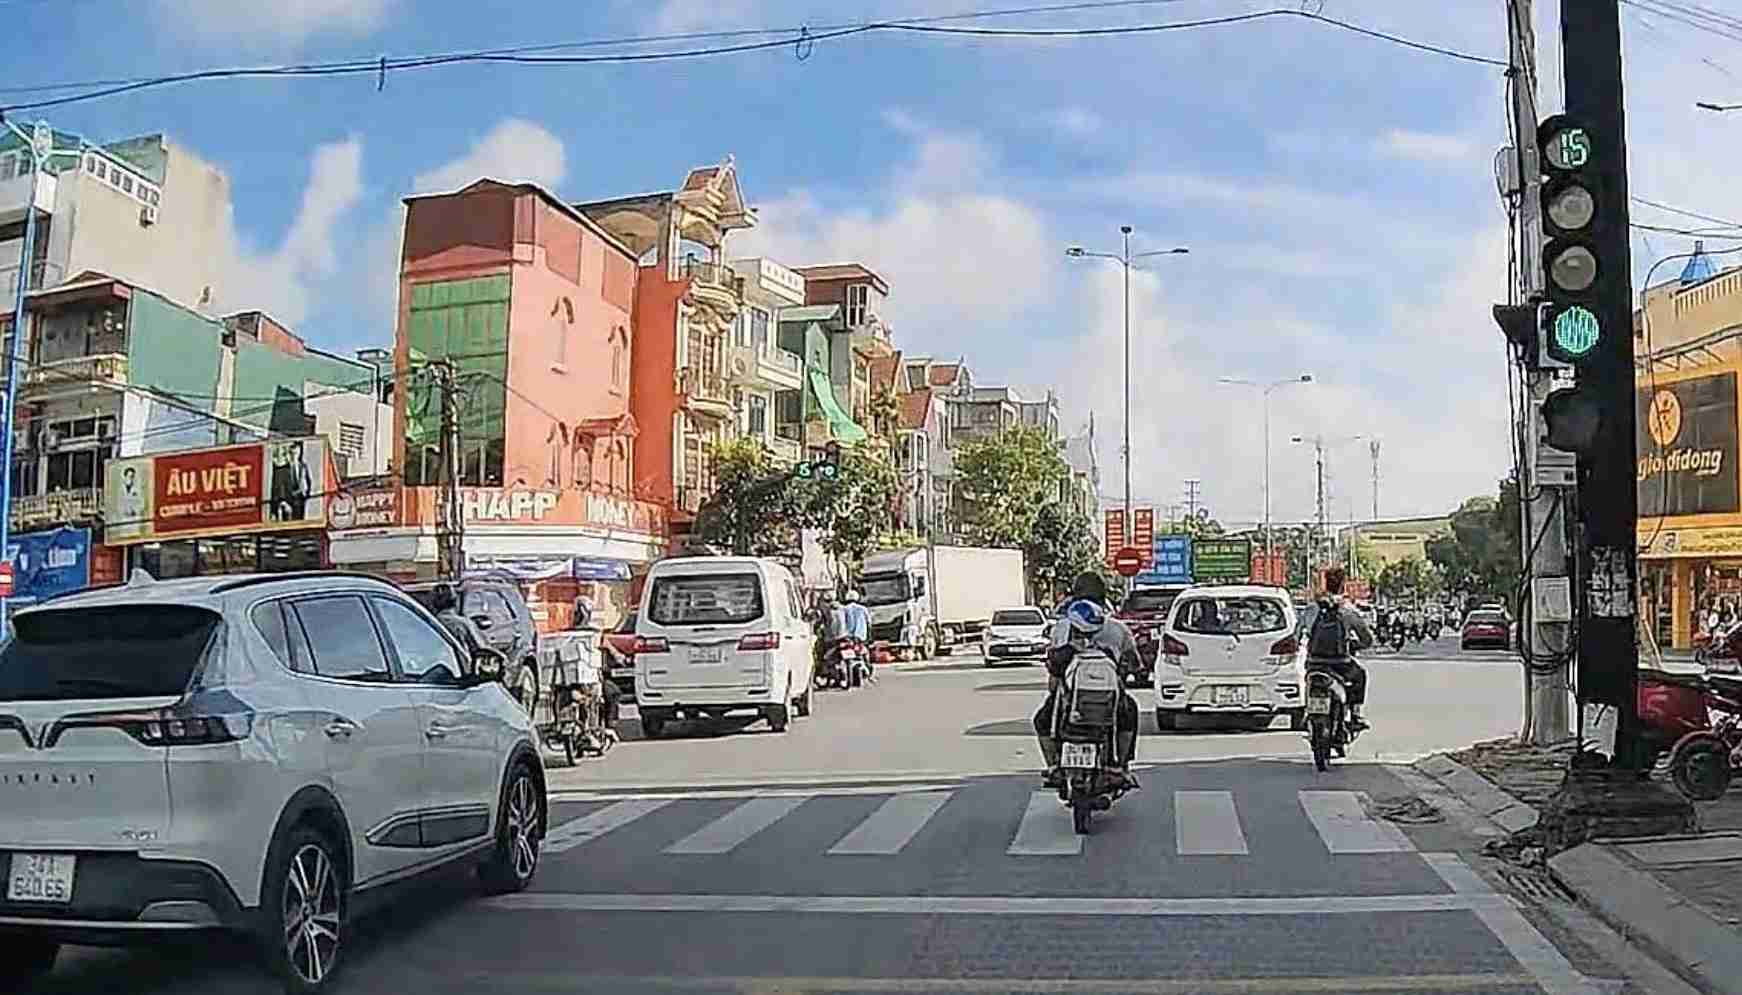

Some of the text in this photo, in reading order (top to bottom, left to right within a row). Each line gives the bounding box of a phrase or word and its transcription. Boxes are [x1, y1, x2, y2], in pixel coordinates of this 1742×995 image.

[1561, 128, 1587, 166] 15
[167, 461, 252, 496] ÂU VIỆT
